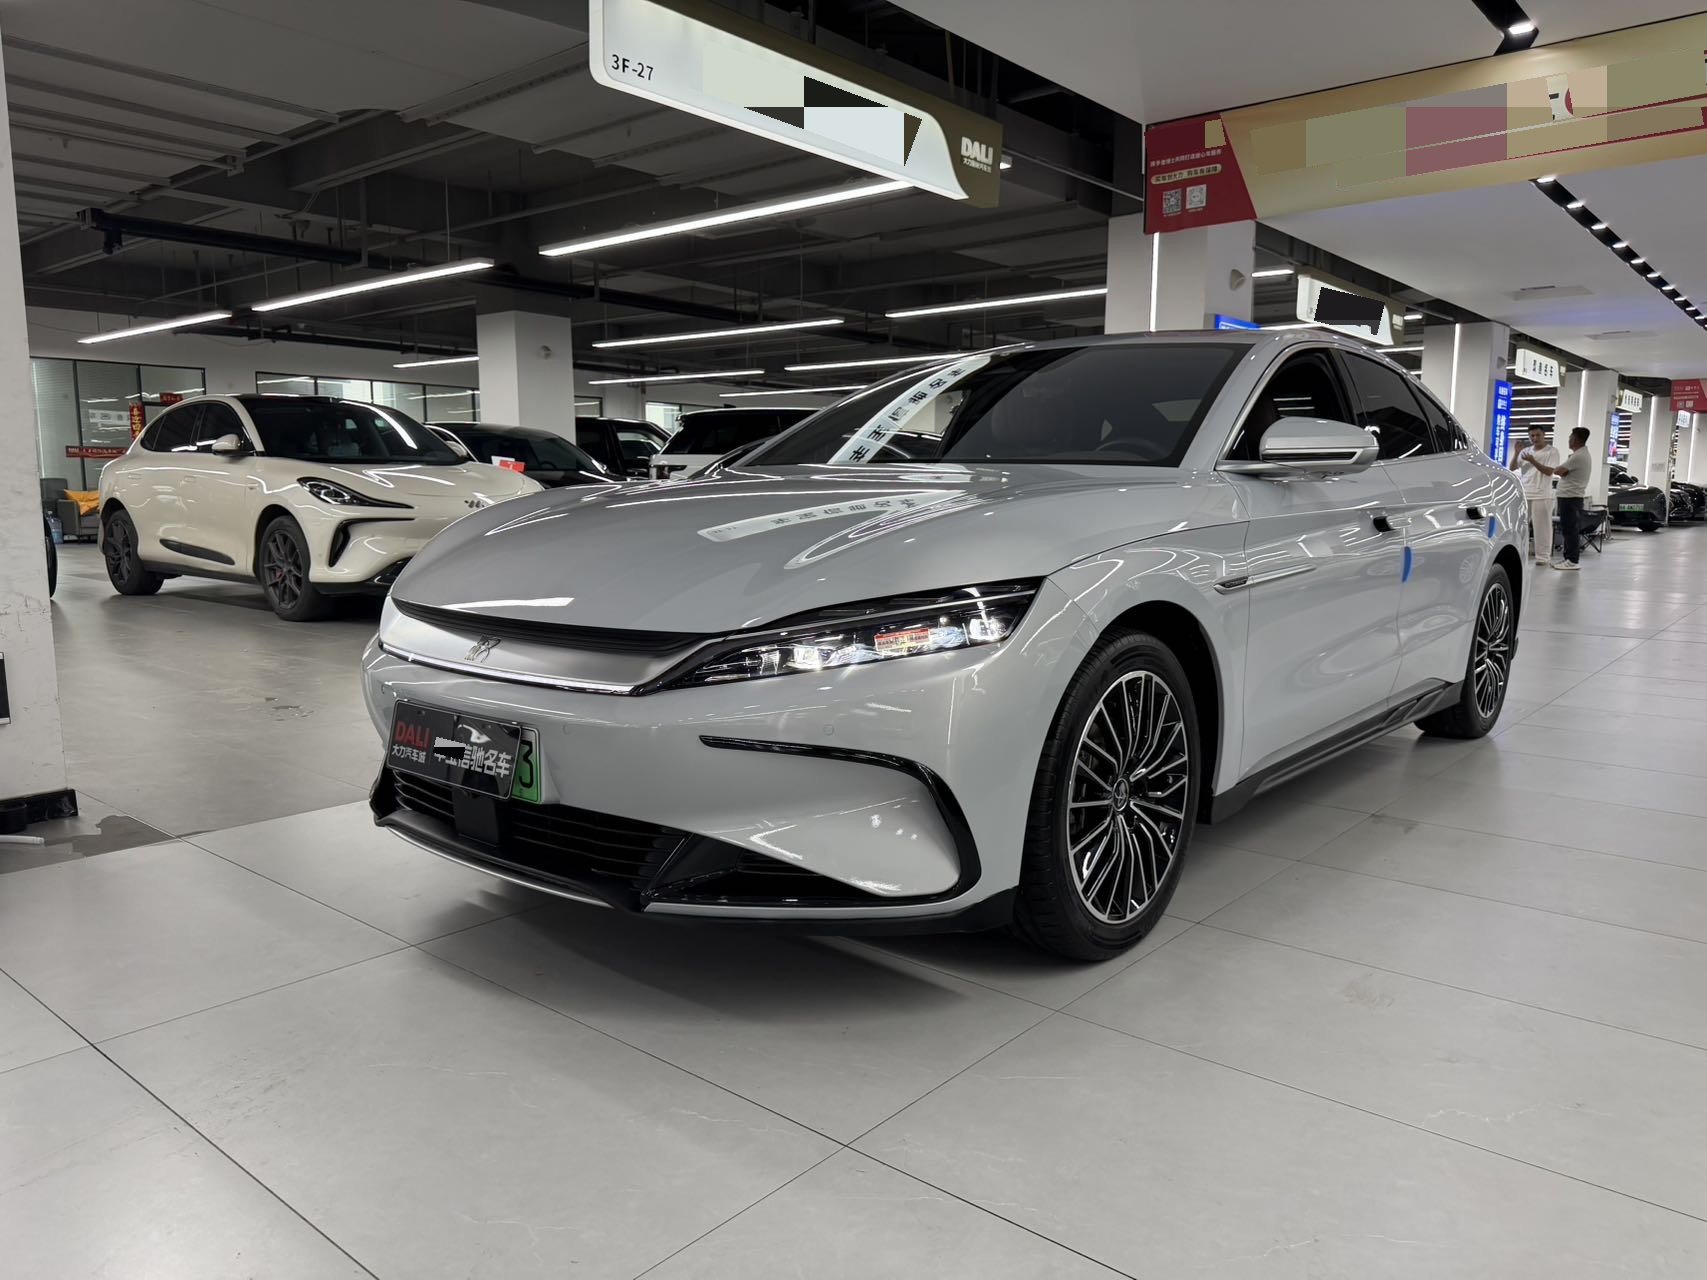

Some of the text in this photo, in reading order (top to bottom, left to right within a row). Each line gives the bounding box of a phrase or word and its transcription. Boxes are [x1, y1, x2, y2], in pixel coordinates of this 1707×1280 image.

[611, 54, 654, 81] 3F-27
[961, 136, 994, 166] DALI
[394, 721, 432, 749] DALI
[433, 738, 512, 779] 信驰名车
[518, 740, 534, 789] 3
